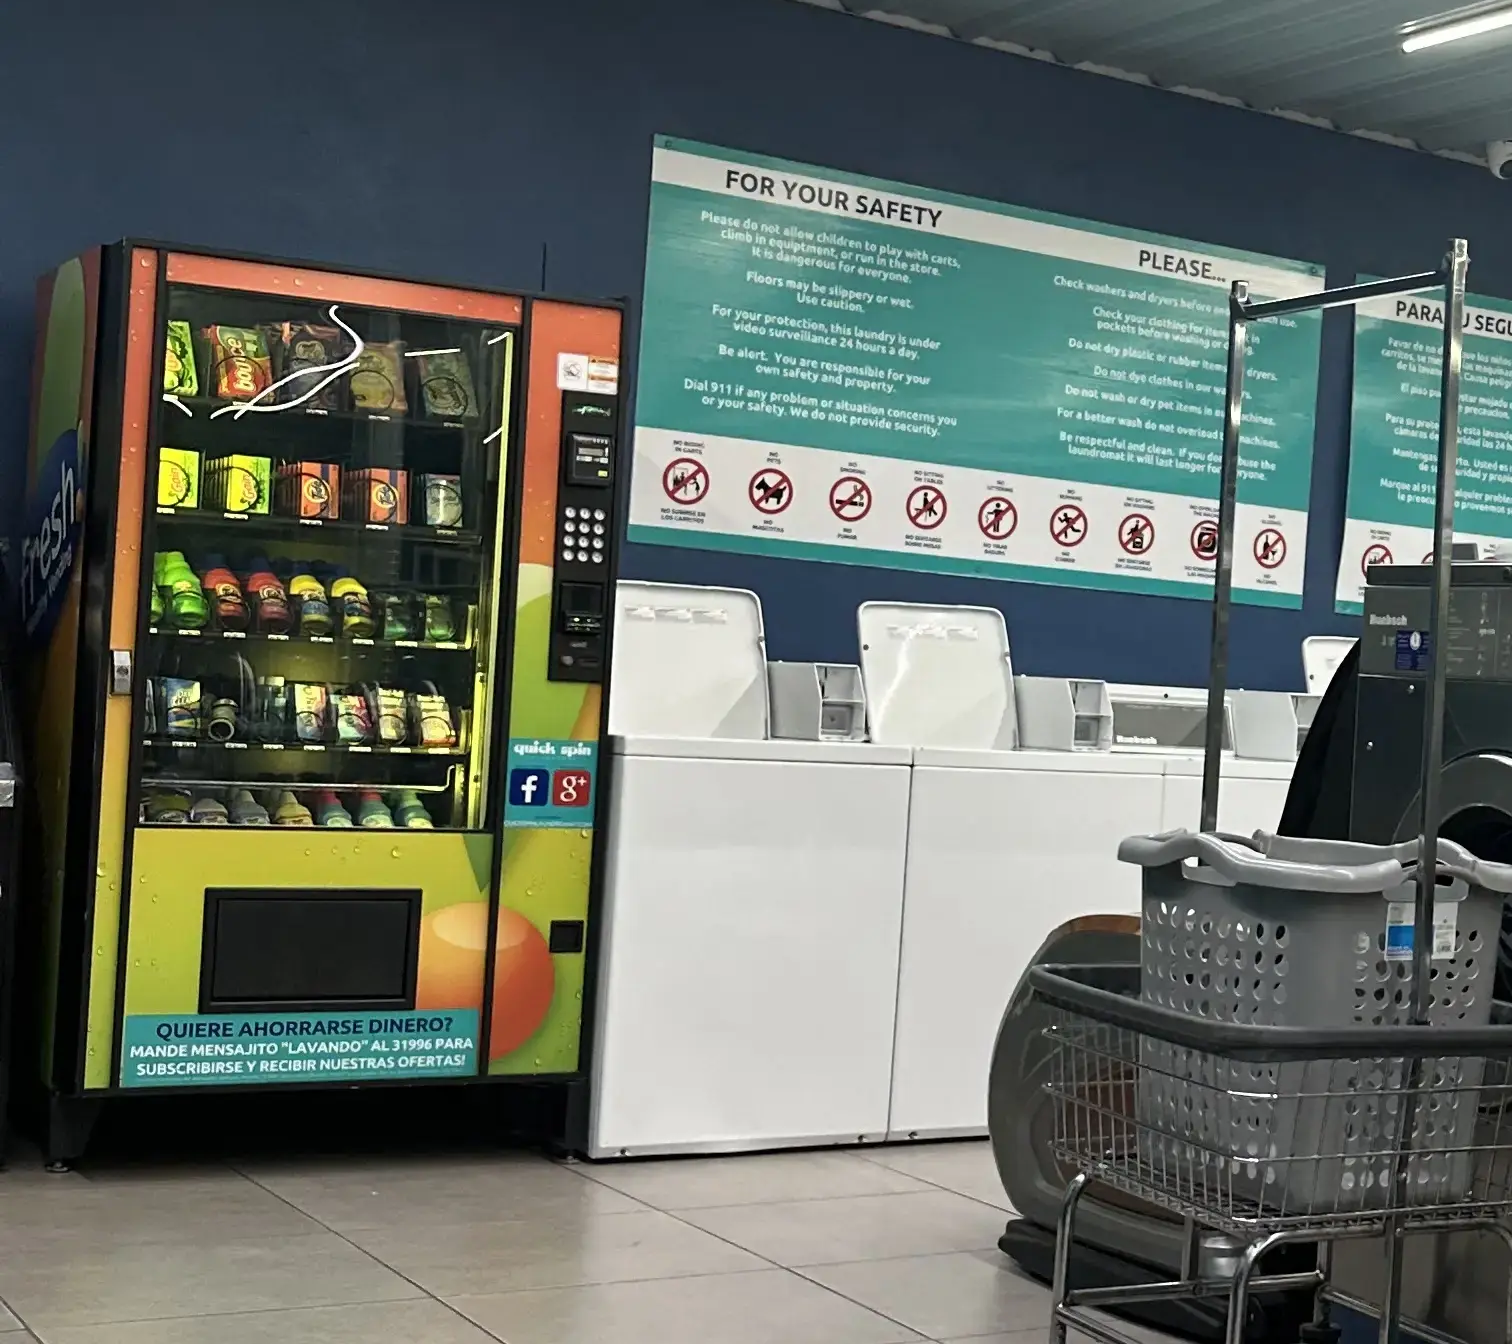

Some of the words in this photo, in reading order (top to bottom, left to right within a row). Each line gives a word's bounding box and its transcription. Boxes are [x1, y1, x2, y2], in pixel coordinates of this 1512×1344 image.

[725, 170, 775, 197] FOR
[782, 180, 849, 211] YOUR
[854, 194, 942, 229] SAFETY
[700, 212, 740, 228] Please
[742, 219, 757, 231] do
[760, 224, 780, 235] not
[782, 227, 814, 241] allow
[816, 232, 862, 249] children
[864, 240, 876, 251] to
[879, 242, 900, 258] play
[904, 247, 928, 260] with
[930, 253, 960, 267] carts,
[720, 229, 752, 243] climb
[754, 234, 765, 245] in
[840, 250, 852, 260] or
[854, 253, 874, 263] run
[876, 254, 886, 266] in
[888, 257, 907, 269] the
[909, 261, 940, 275] store.
[751, 246, 760, 257] It
[763, 248, 773, 259] is
[776, 250, 836, 270] dangerous
[838, 260, 855, 273] for
[857, 266, 912, 282] everyone.
[1139, 249, 1226, 282] PLEASE...
[746, 271, 784, 287] Floors
[785, 280, 809, 294] may
[812, 281, 826, 294] be
[828, 285, 874, 304] slippery
[876, 294, 888, 303] or
[796, 293, 818, 306] Use
[1053, 275, 1084, 290] Check
[1086, 283, 1126, 297] washers
[1127, 290, 1146, 300] and
[1147, 291, 1178, 306] dryers
[712, 305, 731, 318] For
[734, 308, 761, 322] your
[764, 313, 828, 333] protection,
[830, 323, 851, 336] this
[854, 326, 896, 345] laundry
[898, 333, 907, 344] is
[909, 336, 940, 349] under
[1092, 306, 1122, 320] Check
[1395, 300, 1444, 324] PARA
[732, 320, 766, 334] video
[768, 327, 837, 345] surveillance
[838, 336, 853, 348] 24
[855, 338, 886, 353] hours
[888, 346, 895, 354] a
[897, 345, 919, 360] day.
[1096, 320, 1136, 335] pockets
[718, 345, 734, 357] Be
[774, 352, 797, 365] You
[799, 358, 818, 368] are
[820, 361, 884, 377] responsible
[886, 367, 904, 380] for
[905, 370, 930, 384] your
[1068, 338, 1082, 349] Do
[1103, 343, 1120, 358] dry
[1156, 354, 1166, 362] or
[1168, 355, 1200, 368] rubber
[755, 366, 780, 376] own
[782, 368, 818, 384] safety
[820, 374, 842, 385] and
[844, 375, 896, 394] property.
[1093, 366, 1108, 377] Do
[1128, 371, 1146, 385] dye
[683, 379, 708, 392] Dial
[710, 383, 732, 396] 911
[734, 386, 744, 397] if
[746, 389, 766, 403] any
[770, 390, 818, 407] problem
[820, 400, 833, 409] or
[835, 400, 884, 415] situation
[886, 408, 934, 422] concerns
[936, 412, 958, 426] you
[1064, 384, 1079, 395] Do
[1100, 392, 1125, 402] wash
[1126, 396, 1139, 404] or
[1141, 395, 1156, 409] dry
[1157, 398, 1174, 411] pet
[701, 397, 714, 406] or
[716, 396, 744, 410] your
[747, 401, 786, 417] safety.
[790, 405, 808, 418] We
[810, 408, 825, 420] do
[827, 413, 847, 423] not
[849, 413, 891, 428] provide
[894, 421, 940, 437] security.
[1056, 406, 1073, 418] For
[1084, 410, 1115, 424] better
[1117, 418, 1142, 428] wash
[1144, 419, 1156, 430] do
[1059, 431, 1073, 442] Be
[1126, 442, 1145, 452] and
[1187, 449, 1204, 461] you
[514, 741, 556, 756] quick
[560, 742, 591, 757] spin
[156, 1022, 234, 1042] QUIERE
[240, 1019, 364, 1036] AHORRARSE
[369, 1017, 453, 1034] DINERO?
[130, 1045, 188, 1058] MANDE
[191, 1043, 278, 1057] MENSAJITO
[281, 1040, 369, 1054] "LAVANDO"
[370, 1040, 390, 1052] AL
[392, 1039, 432, 1052] 31996
[435, 1038, 474, 1049] PARA
[136, 1061, 244, 1076] SUBSCRIBIRSE
[247, 1061, 257, 1073] Y
[260, 1059, 317, 1073] RECIBIR
[320, 1057, 395, 1070] NUESTRAS
[397, 1054, 466, 1068] OFERTAS!
